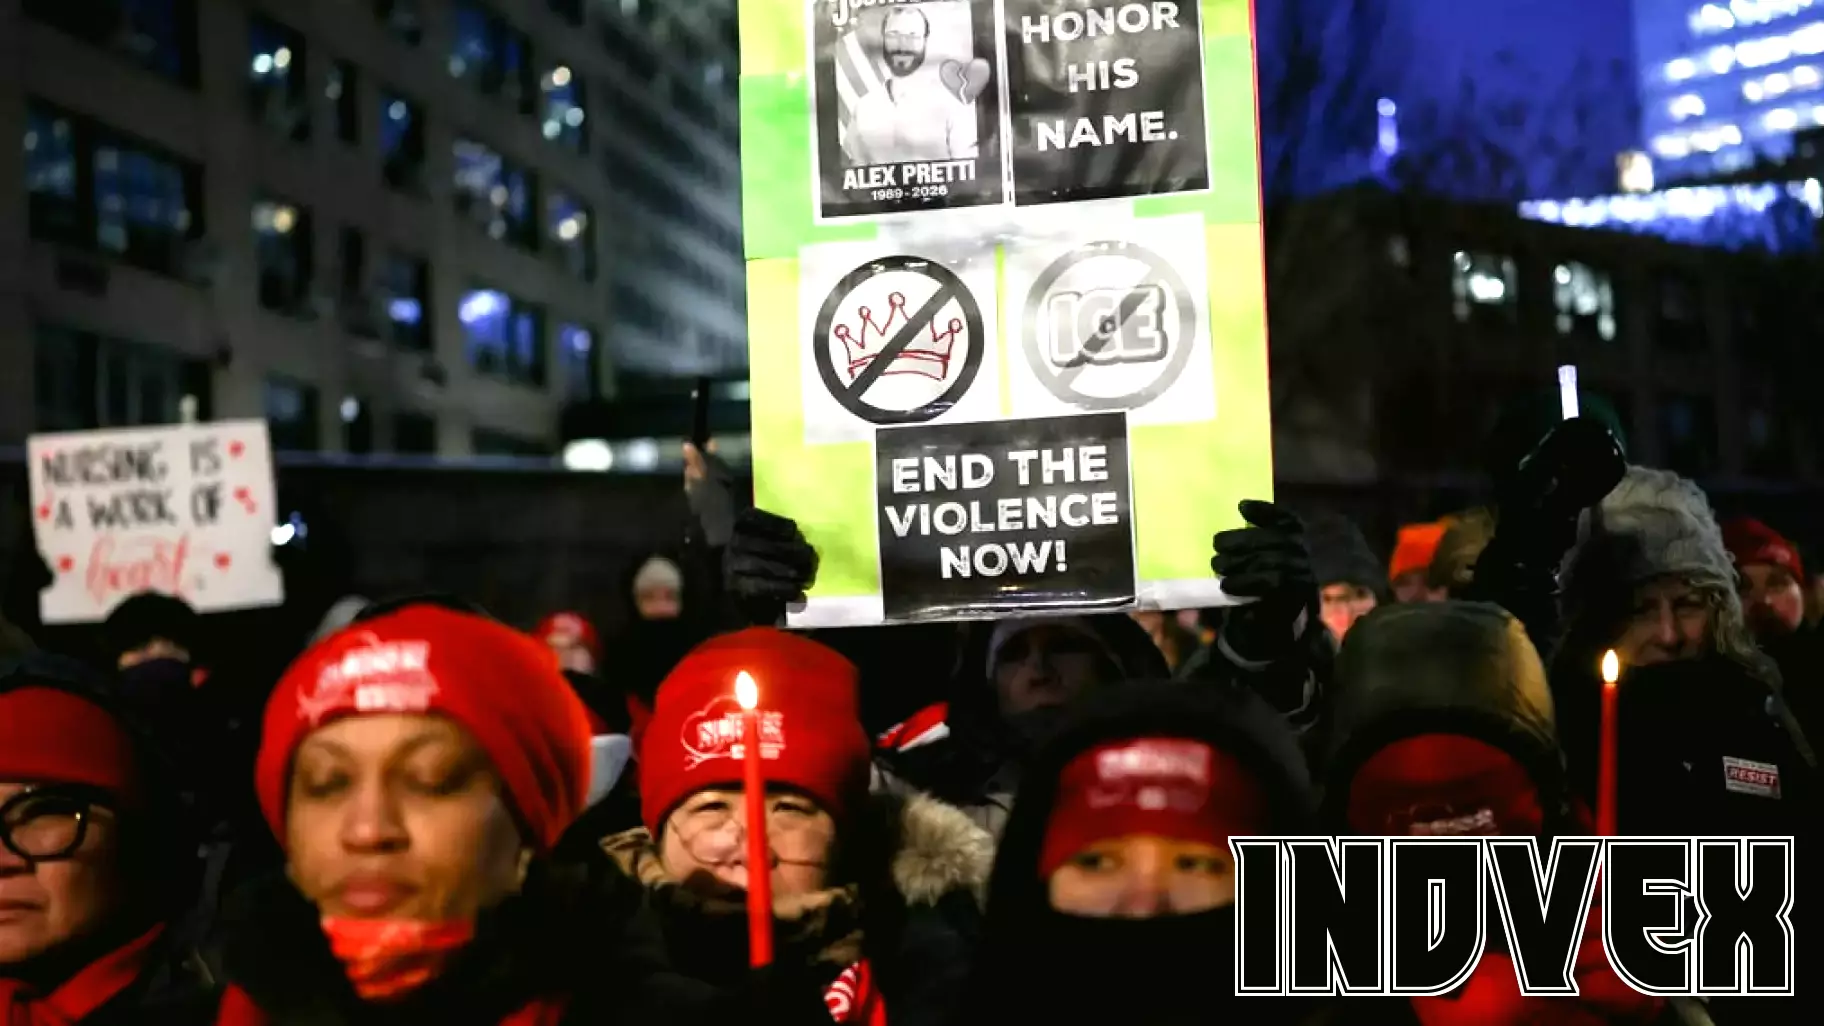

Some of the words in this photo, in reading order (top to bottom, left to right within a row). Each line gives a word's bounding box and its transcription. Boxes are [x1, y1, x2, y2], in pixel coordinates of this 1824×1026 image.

[1022, 2, 1179, 43] HONOR
[1067, 58, 1139, 93] HIS
[1037, 111, 1179, 152] NAME.
[843, 167, 897, 190] ALEX
[902, 160, 976, 185] PRETTI
[1051, 287, 1165, 363] ICE
[892, 453, 994, 494] END
[1008, 445, 1109, 486] THE
[55, 498, 74, 530] A
[884, 492, 1119, 537] VIOLENCE
[940, 539, 1068, 579] NOW!
